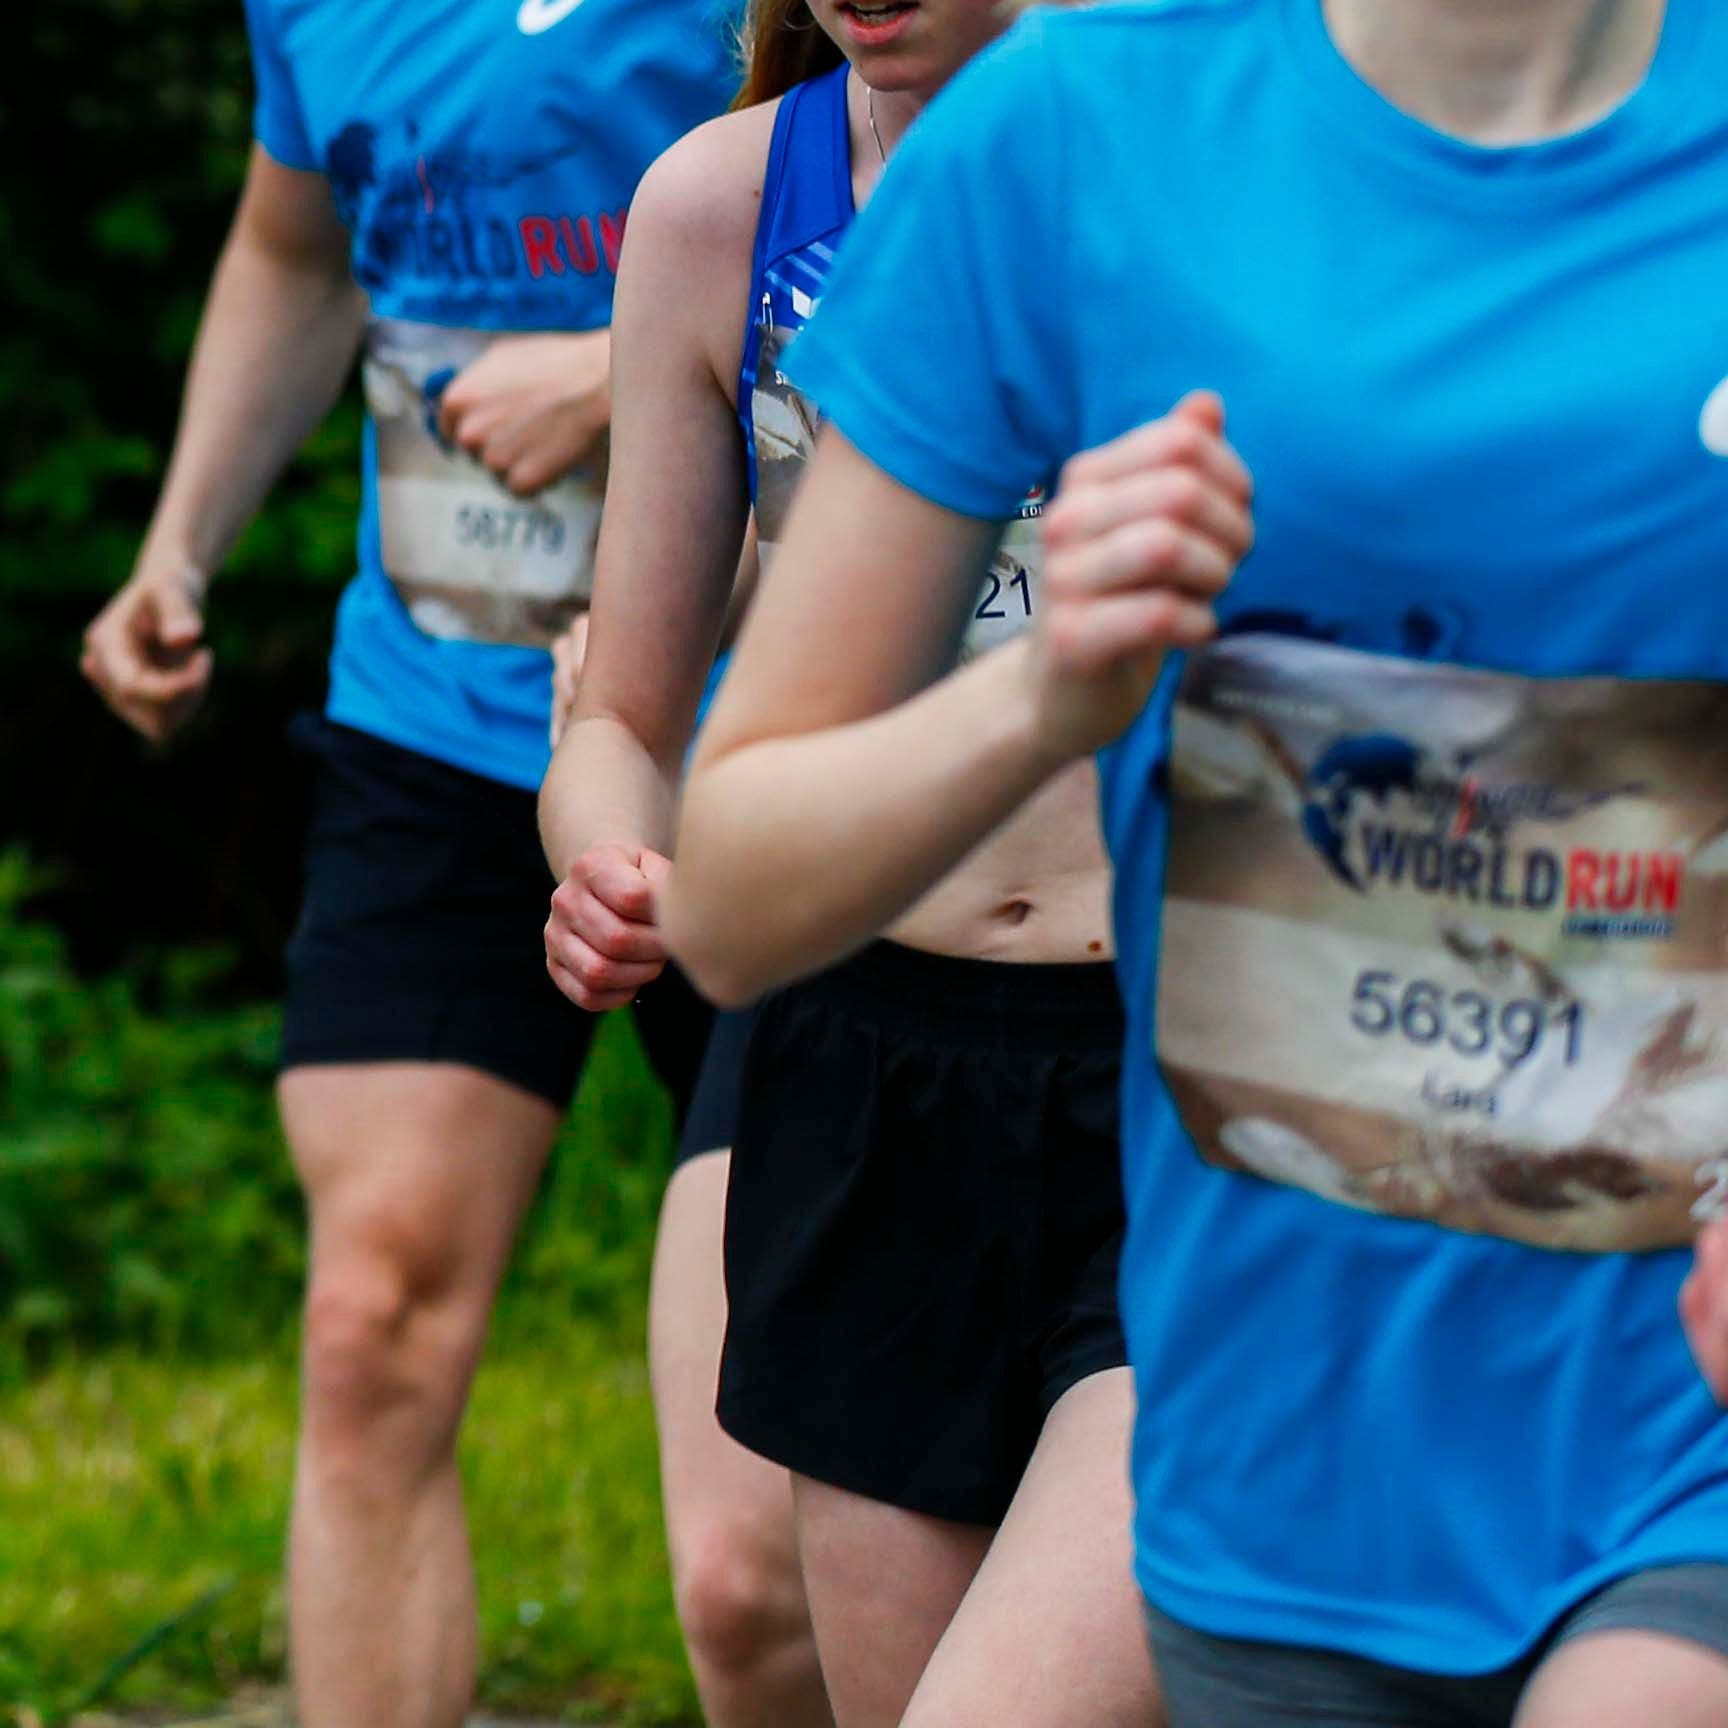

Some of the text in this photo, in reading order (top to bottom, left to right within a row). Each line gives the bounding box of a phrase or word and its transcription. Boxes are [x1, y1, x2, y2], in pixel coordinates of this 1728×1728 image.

[1362, 823, 1683, 913] WORLD RUN
[1350, 969, 1585, 1069] 56391
